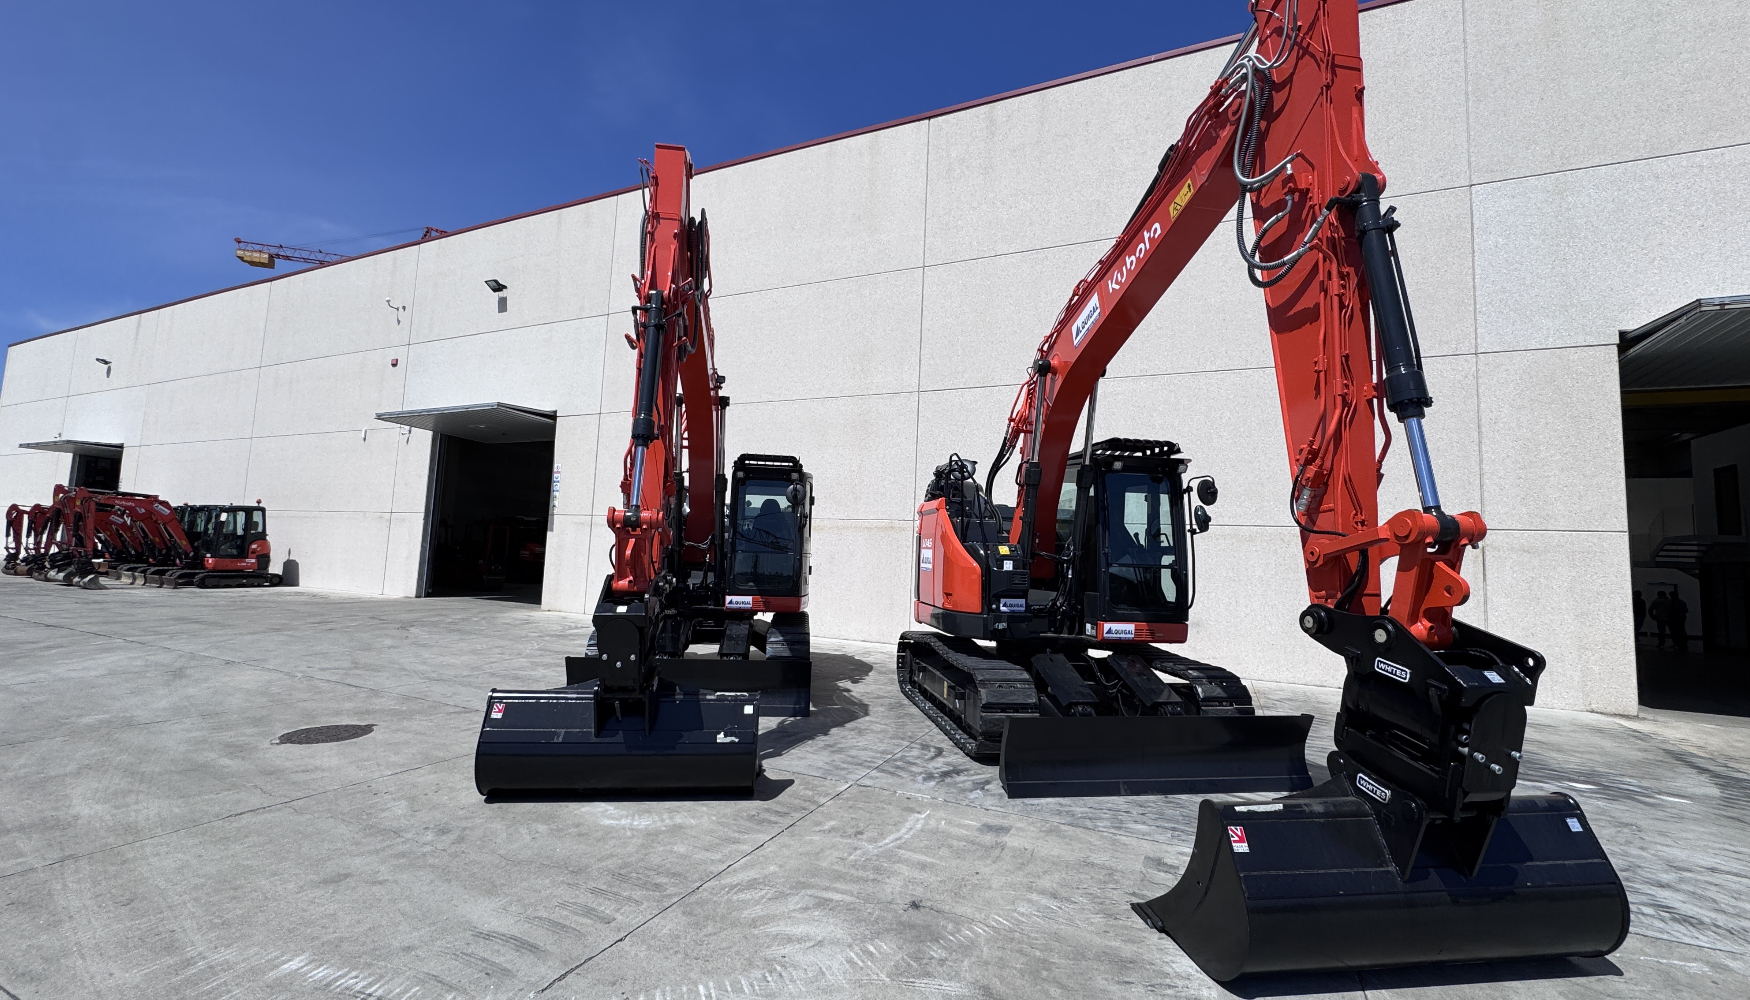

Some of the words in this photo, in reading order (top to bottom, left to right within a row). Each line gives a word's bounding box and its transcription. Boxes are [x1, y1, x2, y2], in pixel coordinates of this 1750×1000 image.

[1107, 222, 1162, 294] Kubota
[1378, 661, 1406, 678] WHITES
[1360, 778, 1386, 799] WHITES
